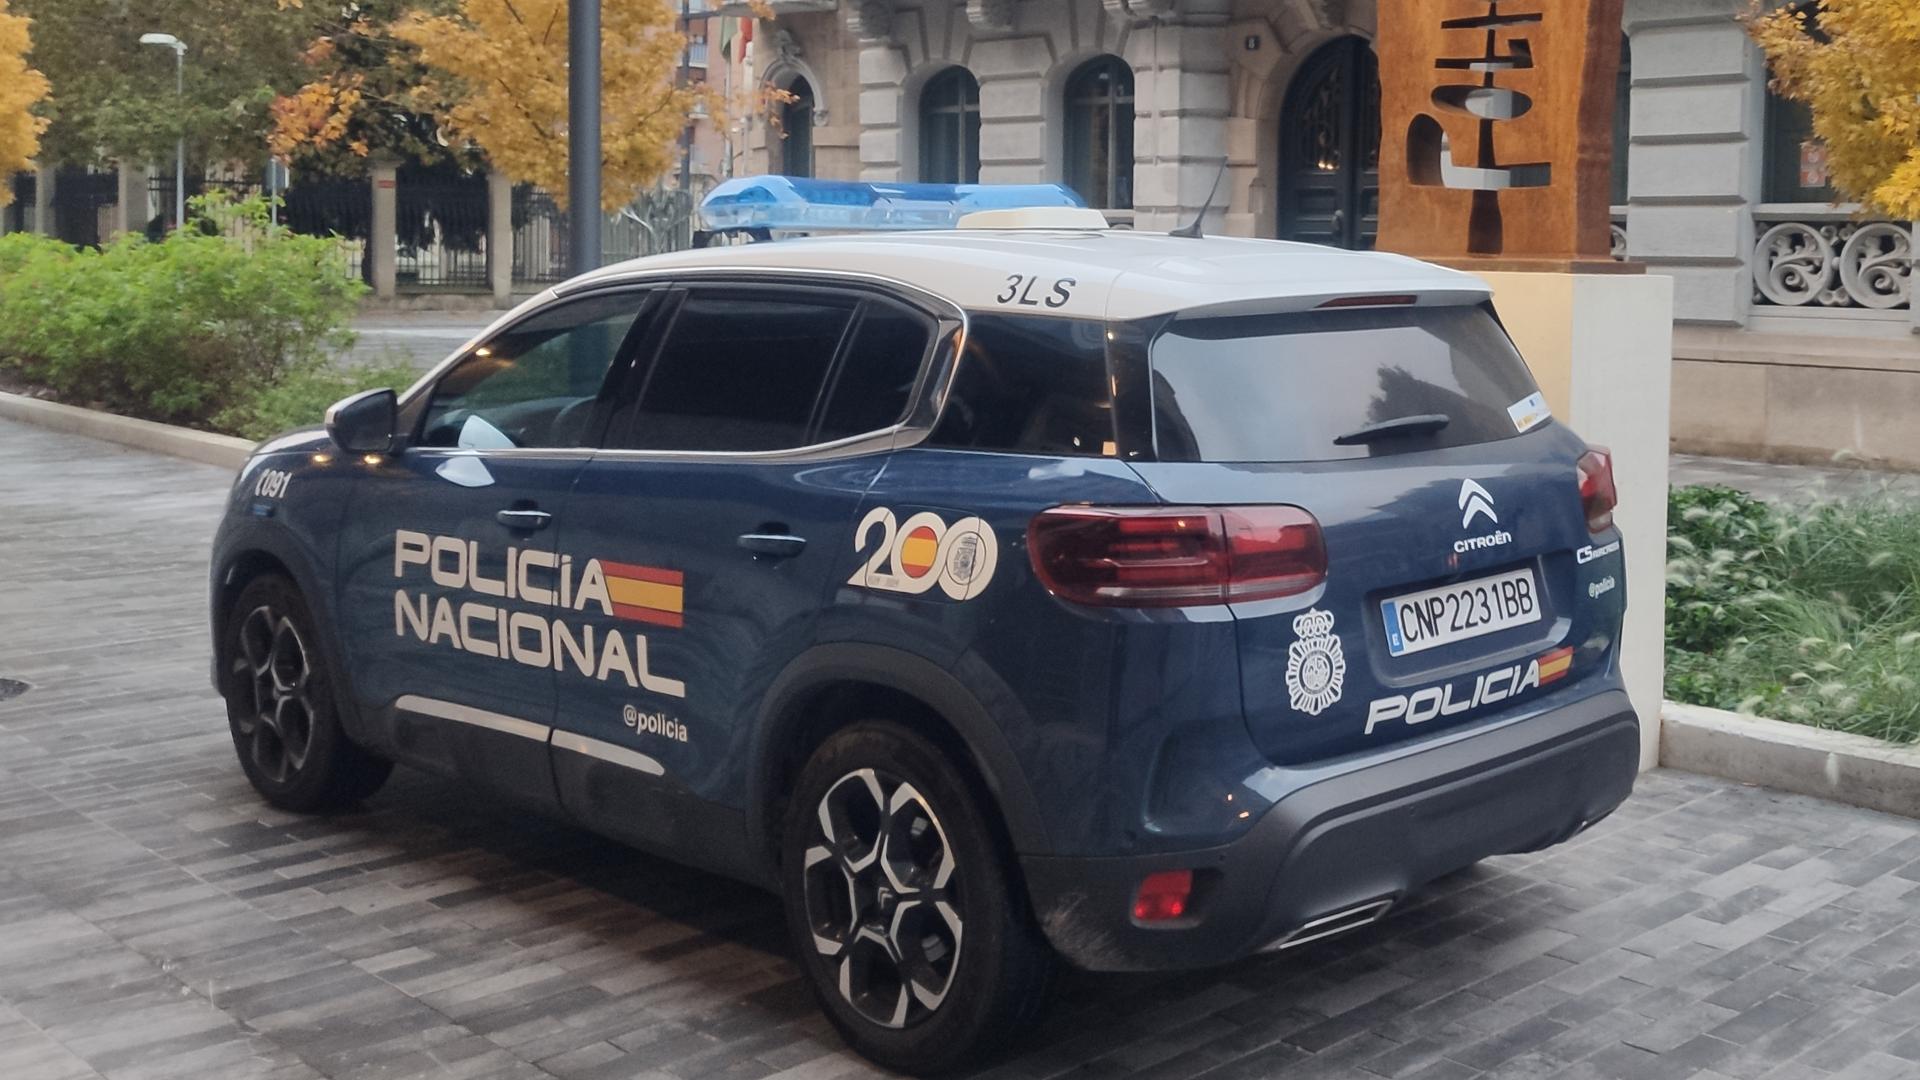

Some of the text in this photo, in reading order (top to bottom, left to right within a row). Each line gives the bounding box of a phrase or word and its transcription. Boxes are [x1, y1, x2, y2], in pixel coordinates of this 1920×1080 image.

[997, 275, 1076, 308] 3LS
[848, 507, 998, 601] 200
[1400, 577, 1533, 642] CNP2231BB
[395, 589, 685, 698] NACIONAL
[623, 704, 688, 742] @policia
